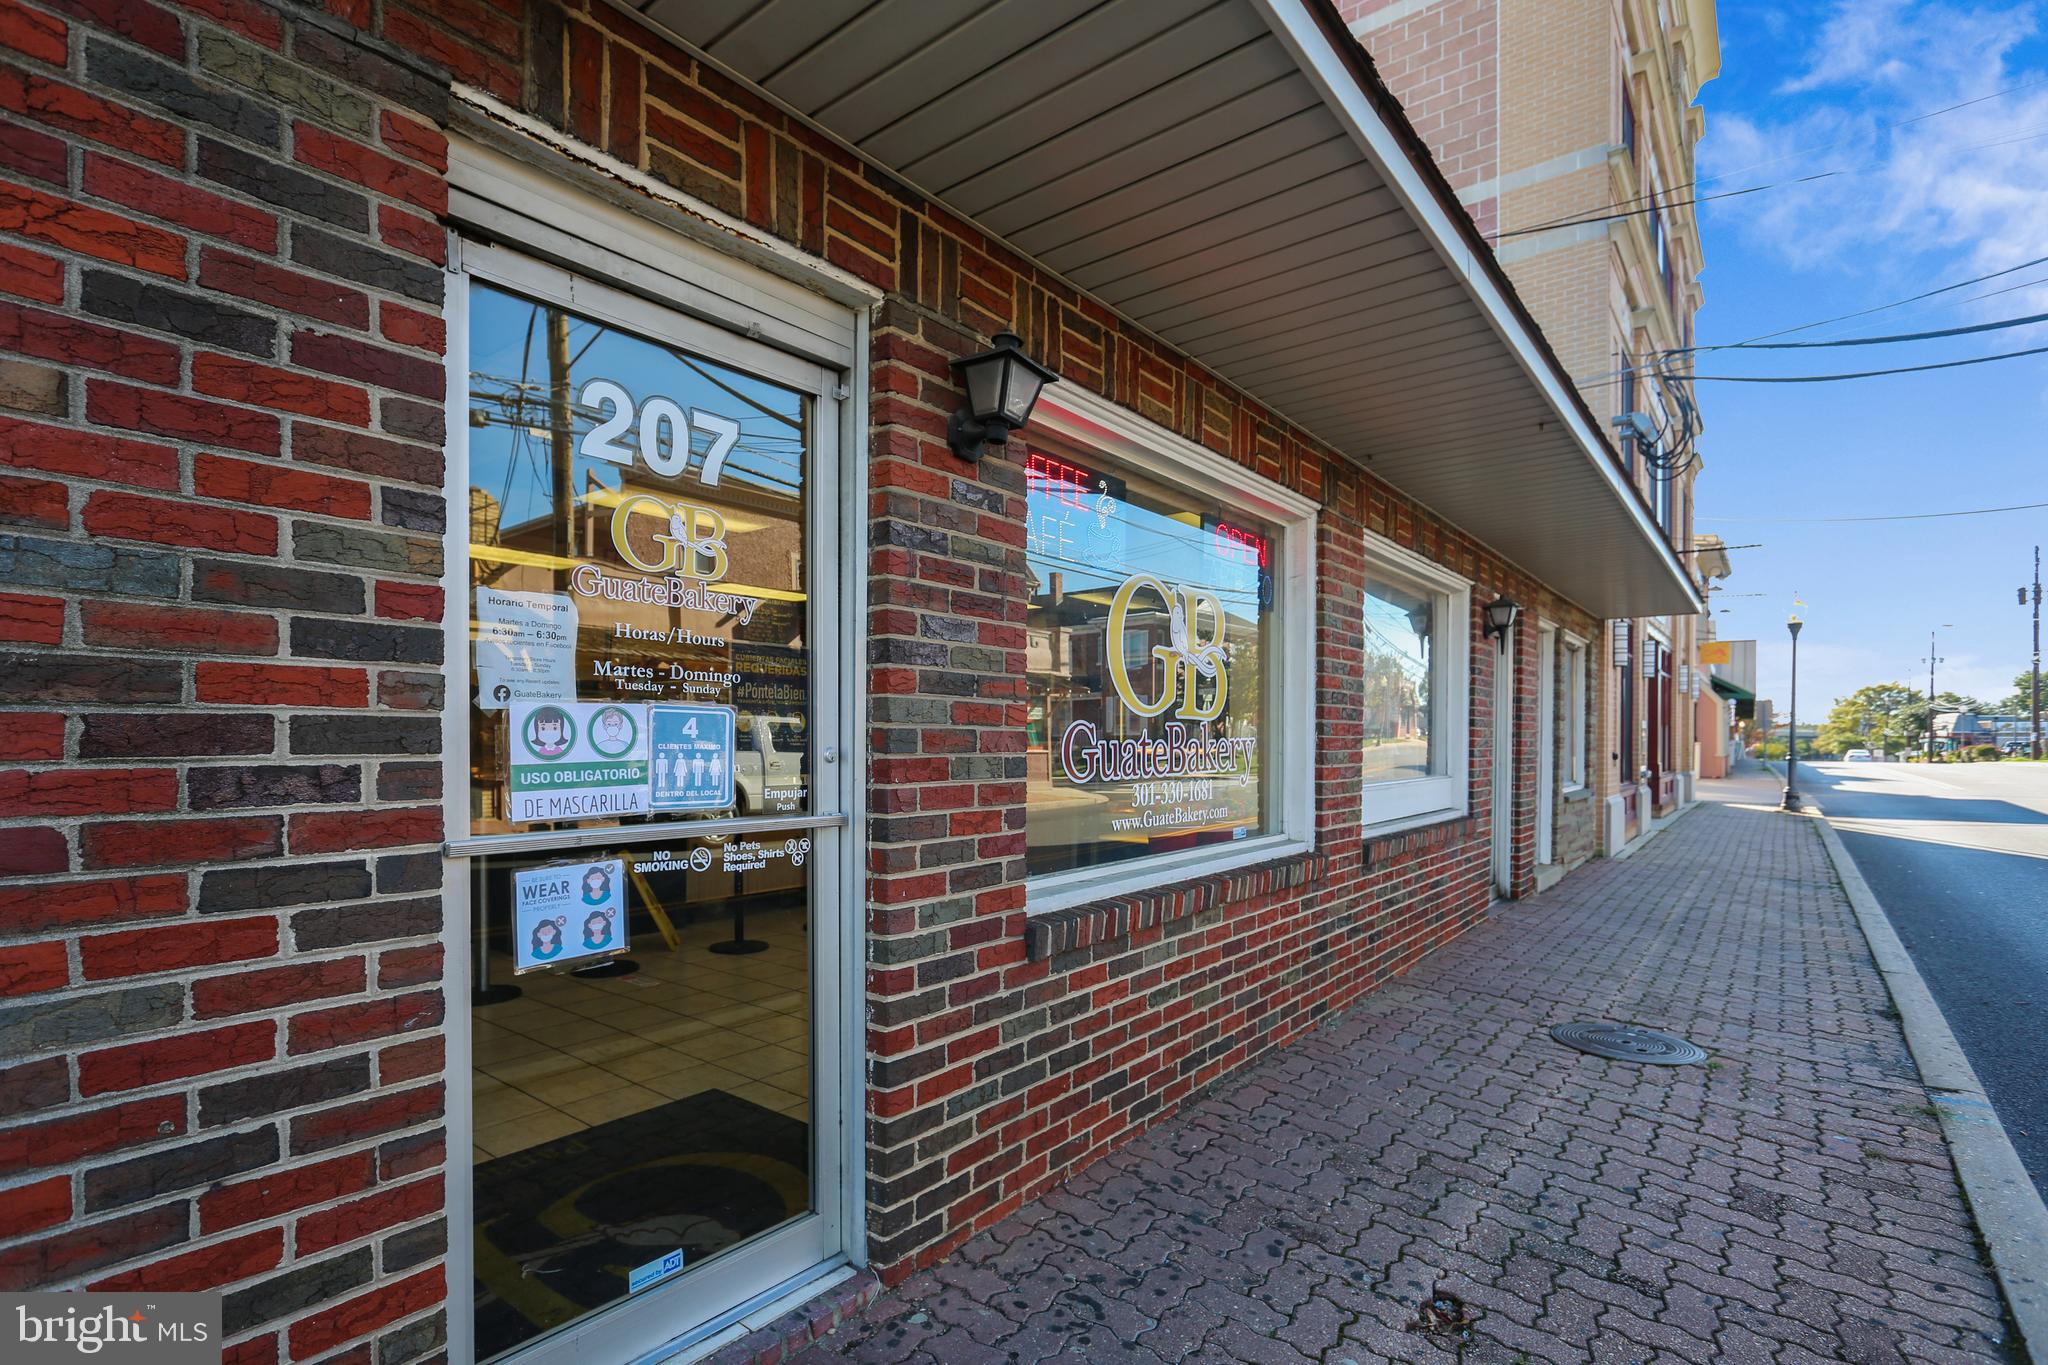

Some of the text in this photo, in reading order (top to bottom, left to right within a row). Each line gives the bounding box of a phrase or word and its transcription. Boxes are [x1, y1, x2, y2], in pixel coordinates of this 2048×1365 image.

[578, 378, 741, 488] 207
[610, 494, 729, 581] GB
[1215, 523, 1268, 567] OPEN
[571, 564, 758, 625] GuateBakery
[488, 596, 569, 613] Horario Temporal
[498, 617, 524, 628] Martes
[531, 620, 562, 631] Domingo
[492, 626, 525, 638] 6:30am
[536, 630, 567, 641] 6:30pm
[1106, 573, 1228, 721] GB
[593, 660, 654, 679] Martes
[669, 664, 741, 687] Domingo
[735, 661, 808, 676] REQUERIDAS
[514, 690, 562, 699] GuateBakery
[615, 679, 665, 695] Tuesday
[682, 683, 721, 697] Sunday
[682, 717, 699, 738] 4
[1062, 720, 1256, 787] GuateBakery
[521, 769, 640, 784] USO OBLIGATORIO
[764, 787, 808, 801] Empujar
[1132, 780, 1213, 807] 301-330-1681
[524, 793, 639, 818] DE MASCARILLA
[776, 803, 796, 811] Push
[1111, 807, 1228, 831] www.GuateBakery.com
[724, 842, 761, 852] No Pets
[653, 851, 671, 861] NO
[723, 850, 785, 861] Shoes, Shirts
[633, 860, 690, 873] SMOKING
[723, 860, 766, 872] Required
[522, 880, 570, 900] WEAR
[522, 894, 570, 907] FACE COVERINGS
[664, 1257, 680, 1271] ADT
